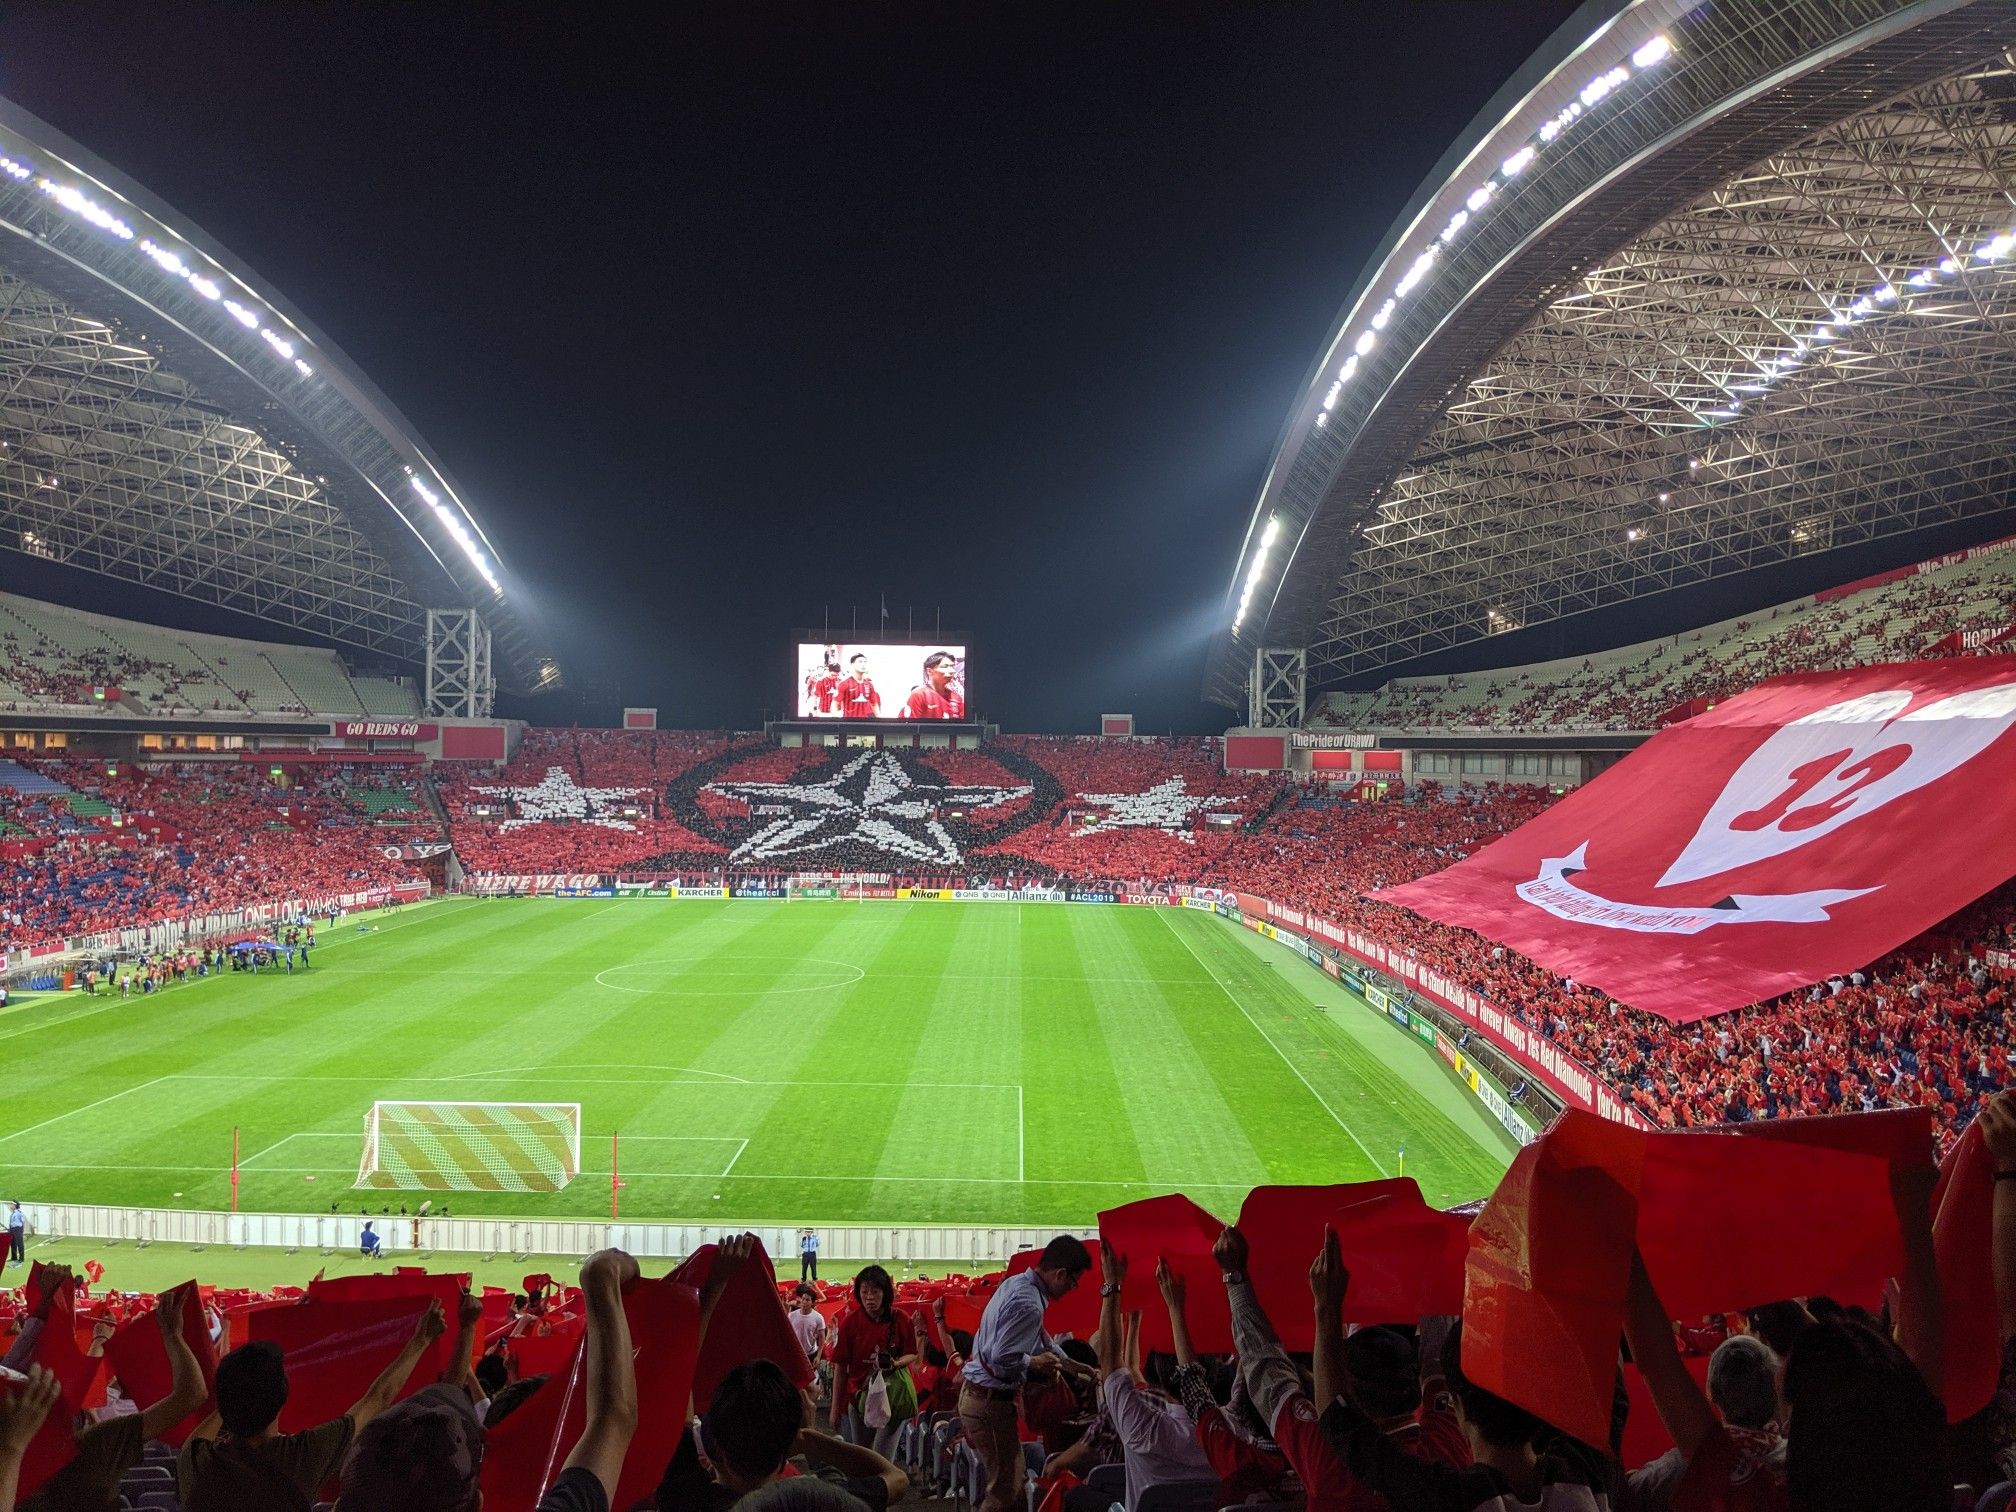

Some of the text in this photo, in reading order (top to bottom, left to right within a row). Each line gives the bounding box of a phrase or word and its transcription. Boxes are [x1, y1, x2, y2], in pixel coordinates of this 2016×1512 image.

[346, 722, 419, 736] GO REDS GO
[1292, 733, 1375, 748] The Pride of URAWA
[1729, 743, 1914, 832] 12
[476, 875, 532, 890] HERE
[557, 890, 612, 898] the-AFC.com
[735, 889, 779, 897] @theafccl
[843, 889, 871, 898] Emirates
[910, 890, 939, 899] Nikon
[1012, 891, 1047, 901] Allianz
[1070, 893, 1114, 902] #ACL2019
[1126, 895, 1170, 905] TOYOTA
[305, 895, 341, 915] VAMOS
[245, 899, 303, 930] ONE LOVE
[1428, 971, 1446, 998] Stand
[1480, 998, 1503, 1035] Forever
[1503, 1014, 1526, 1052] Always
[1527, 1030, 1539, 1062] Yes
[1540, 1039, 1554, 1075] Red
[1555, 1050, 1592, 1107] Diamonds
